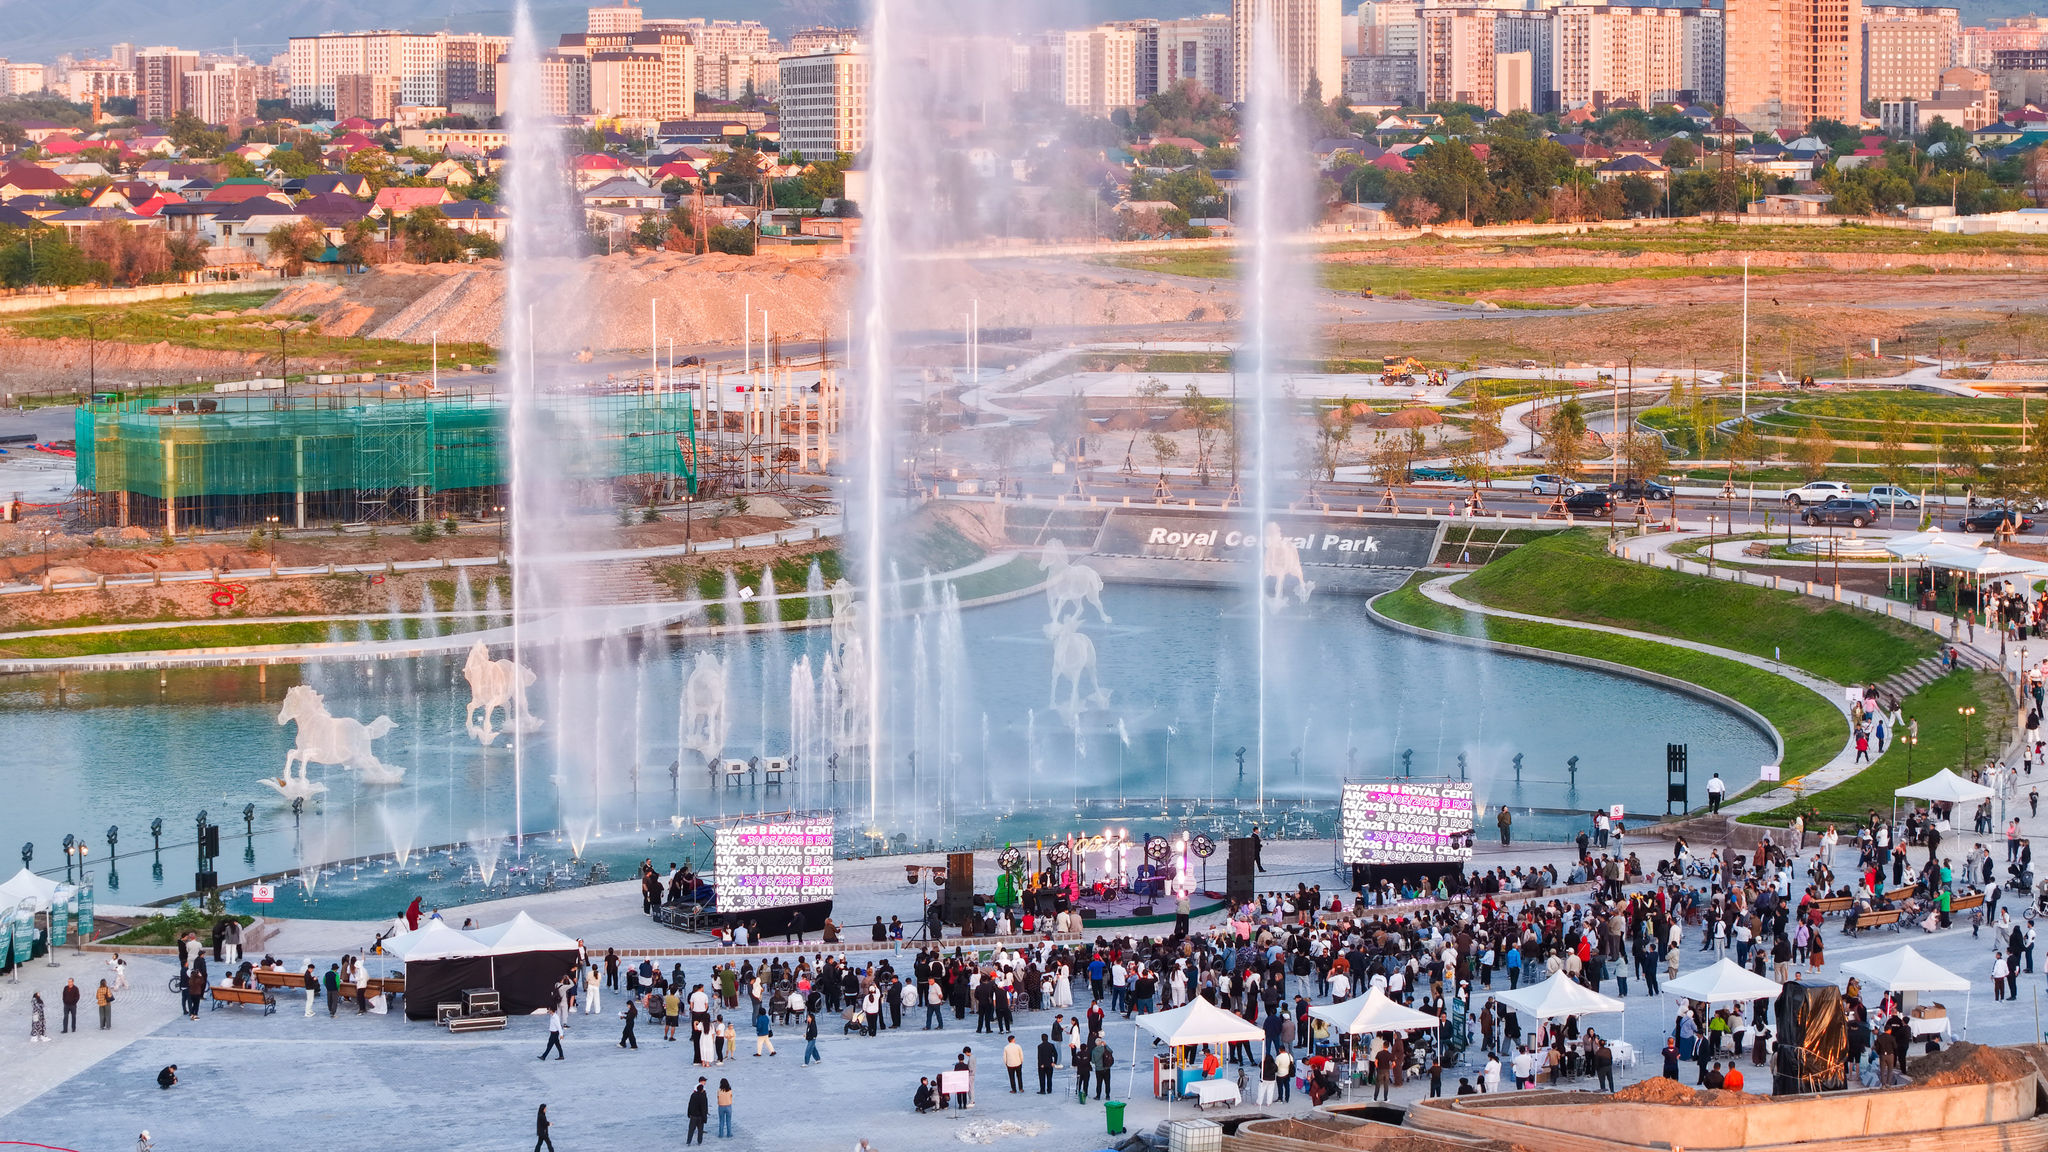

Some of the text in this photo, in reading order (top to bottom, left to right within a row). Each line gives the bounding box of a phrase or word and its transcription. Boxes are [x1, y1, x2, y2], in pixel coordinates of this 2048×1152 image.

[1150, 528, 1217, 548] Royal
[1322, 534, 1381, 552] Park
[1401, 786, 1439, 797] ROYAL
[1442, 788, 1472, 799] CENT
[1400, 805, 1437, 816] ROYAL
[769, 826, 803, 834] ROYAL
[1398, 824, 1435, 835] ROYAL
[768, 846, 802, 855] ROYAL
[1396, 842, 1433, 854] ROYAL
[767, 866, 800, 875] ROYAL
[765, 886, 799, 895] ROYAL
